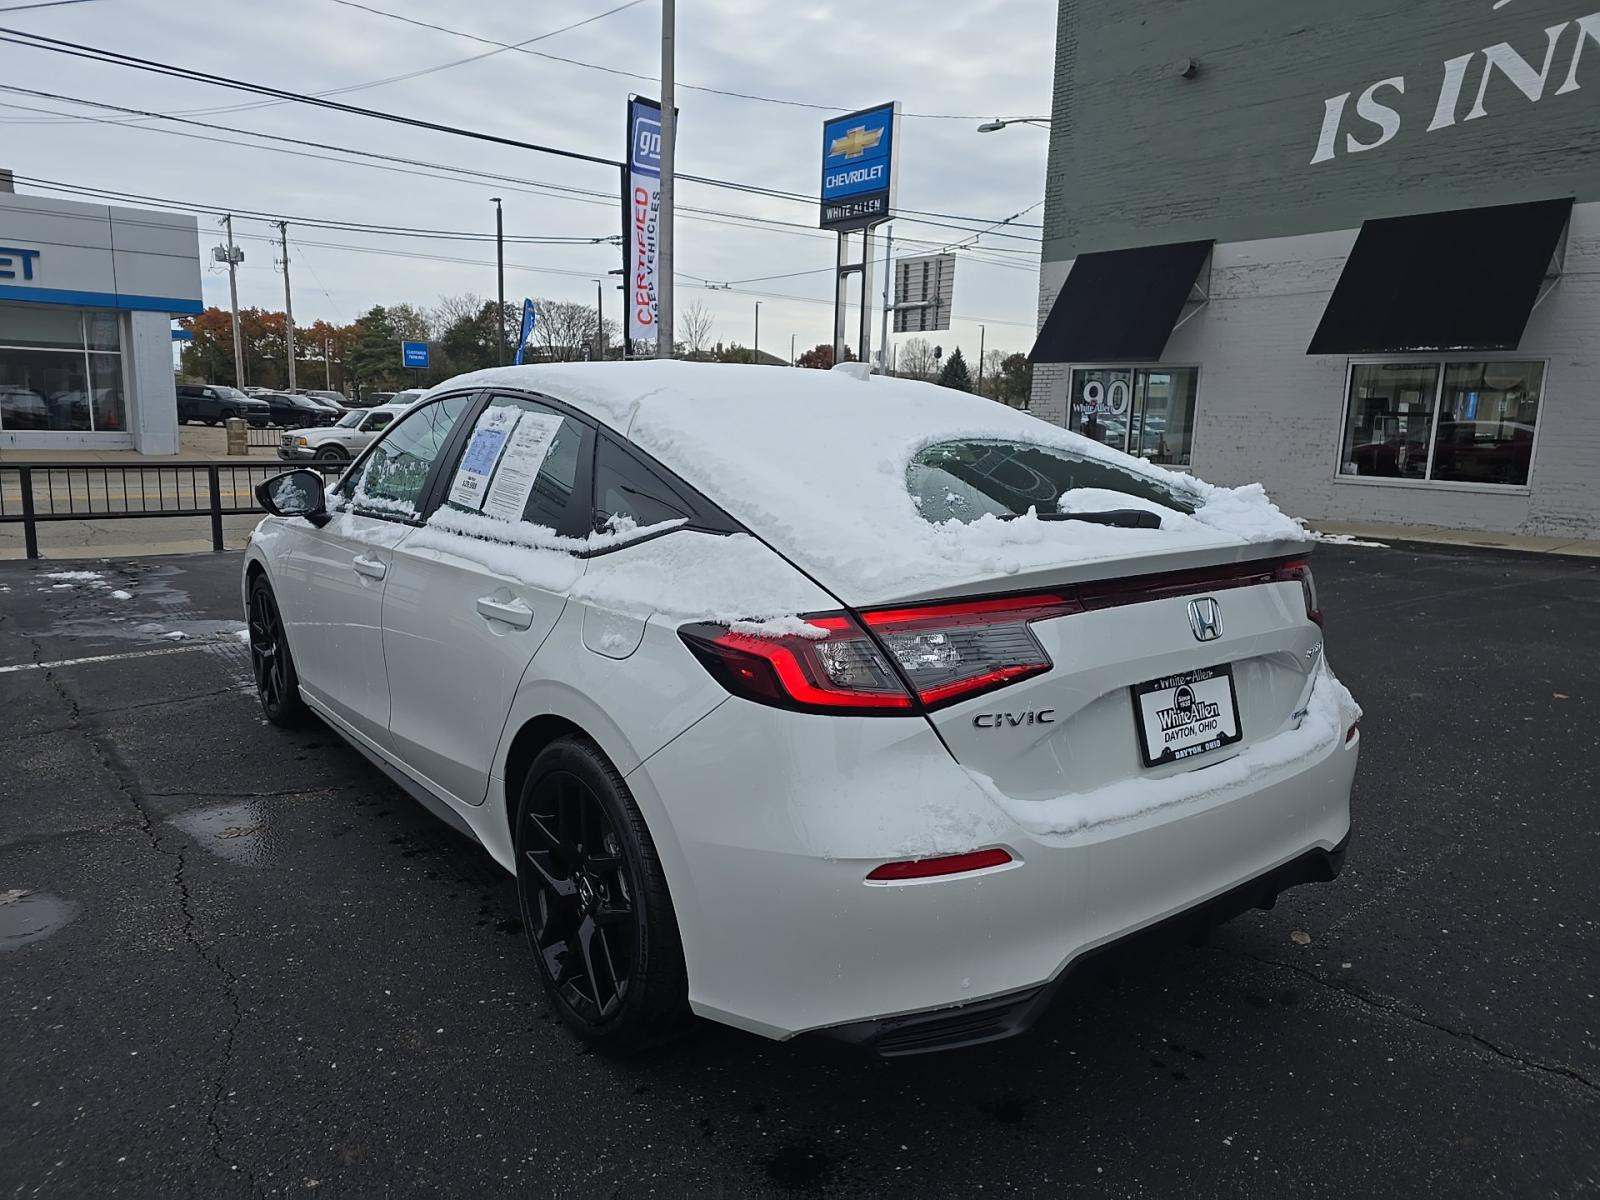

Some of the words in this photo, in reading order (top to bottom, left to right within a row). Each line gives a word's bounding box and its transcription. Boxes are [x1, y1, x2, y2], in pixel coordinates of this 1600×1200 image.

[1309, 76, 1404, 165] IS
[826, 164, 884, 188] CHEVROLET
[826, 204, 851, 219] WHITE
[647, 191, 660, 275] VEHICLES
[635, 186, 653, 325] CERTIFIED
[1083, 380, 1129, 415] 90
[972, 709, 1055, 728] CIVIC
[1165, 725, 1197, 743] DAYTON,
[1199, 719, 1218, 733] OHIO
[1205, 740, 1221, 750] OHIO
